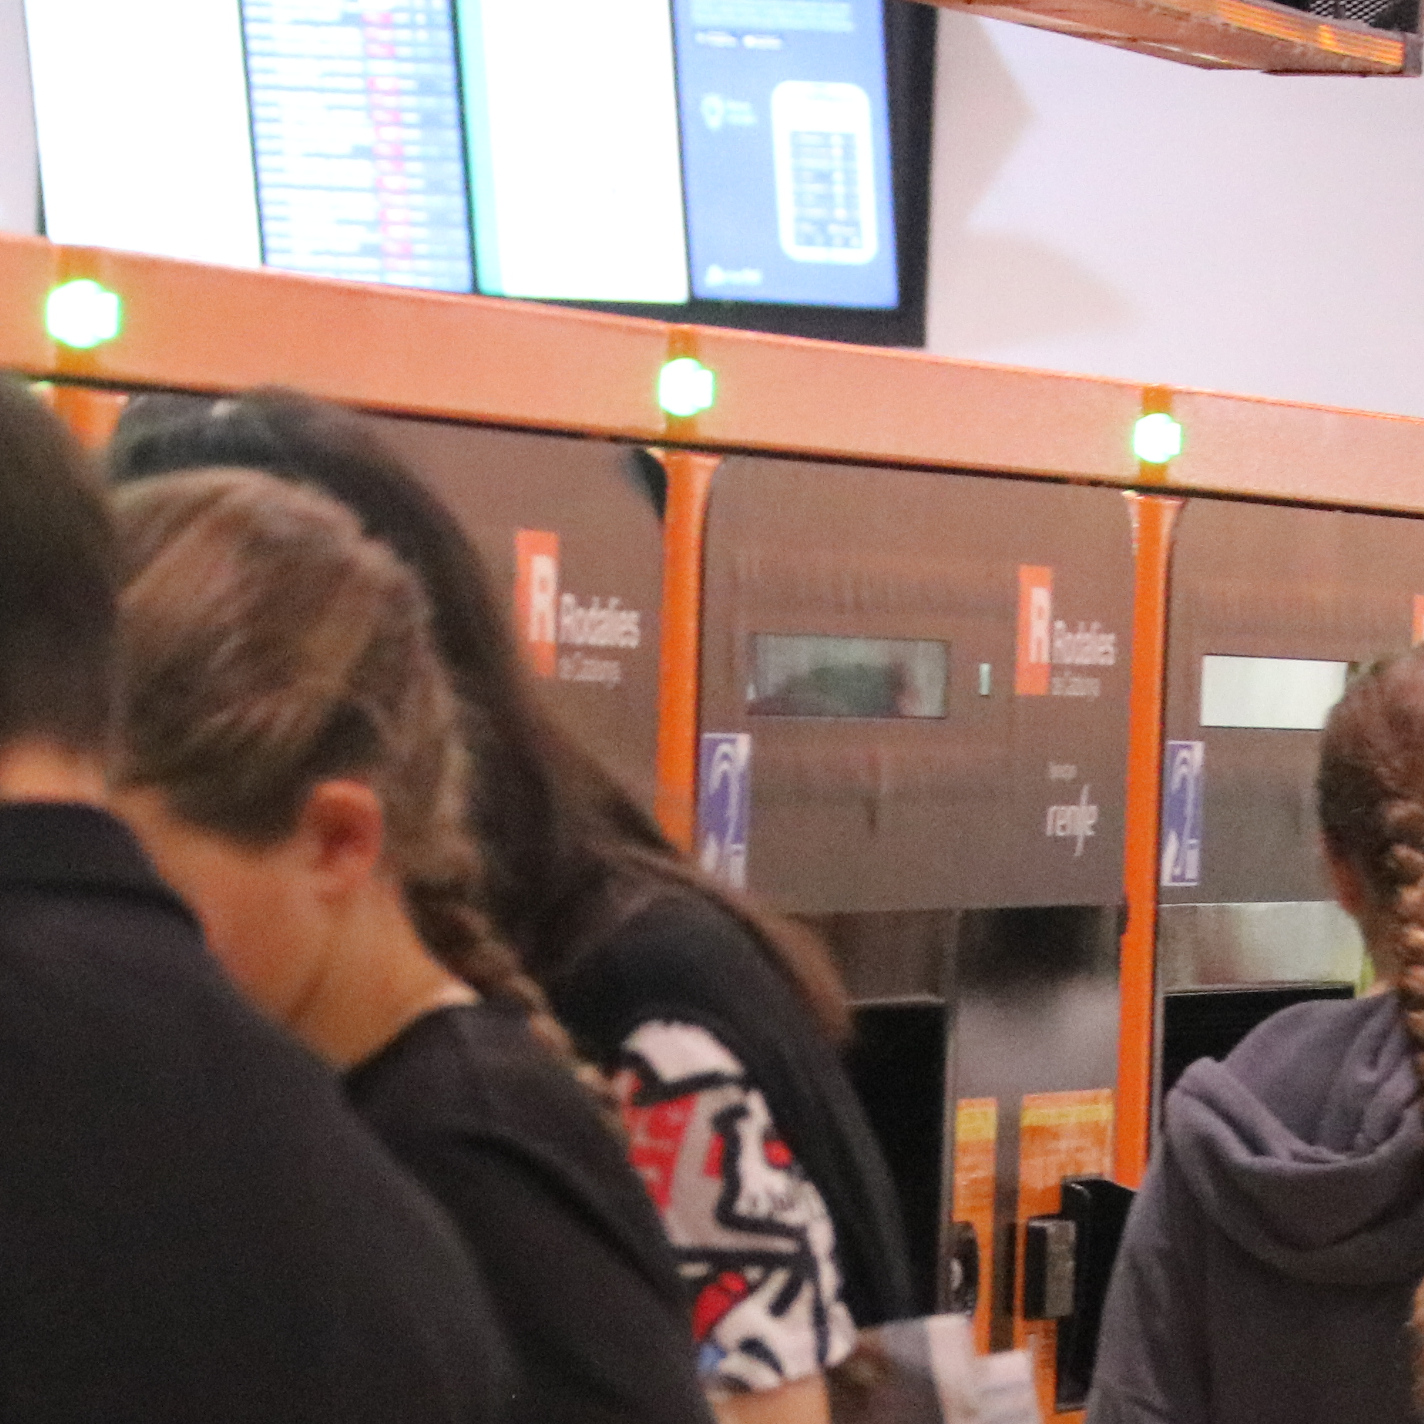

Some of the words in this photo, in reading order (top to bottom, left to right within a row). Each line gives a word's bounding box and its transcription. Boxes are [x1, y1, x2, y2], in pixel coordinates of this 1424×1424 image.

[529, 554, 557, 642] R
[559, 592, 641, 649] Rodalies
[1030, 587, 1051, 663] R
[1052, 620, 1117, 666] Rodalies
[1045, 784, 1099, 857] renfe
